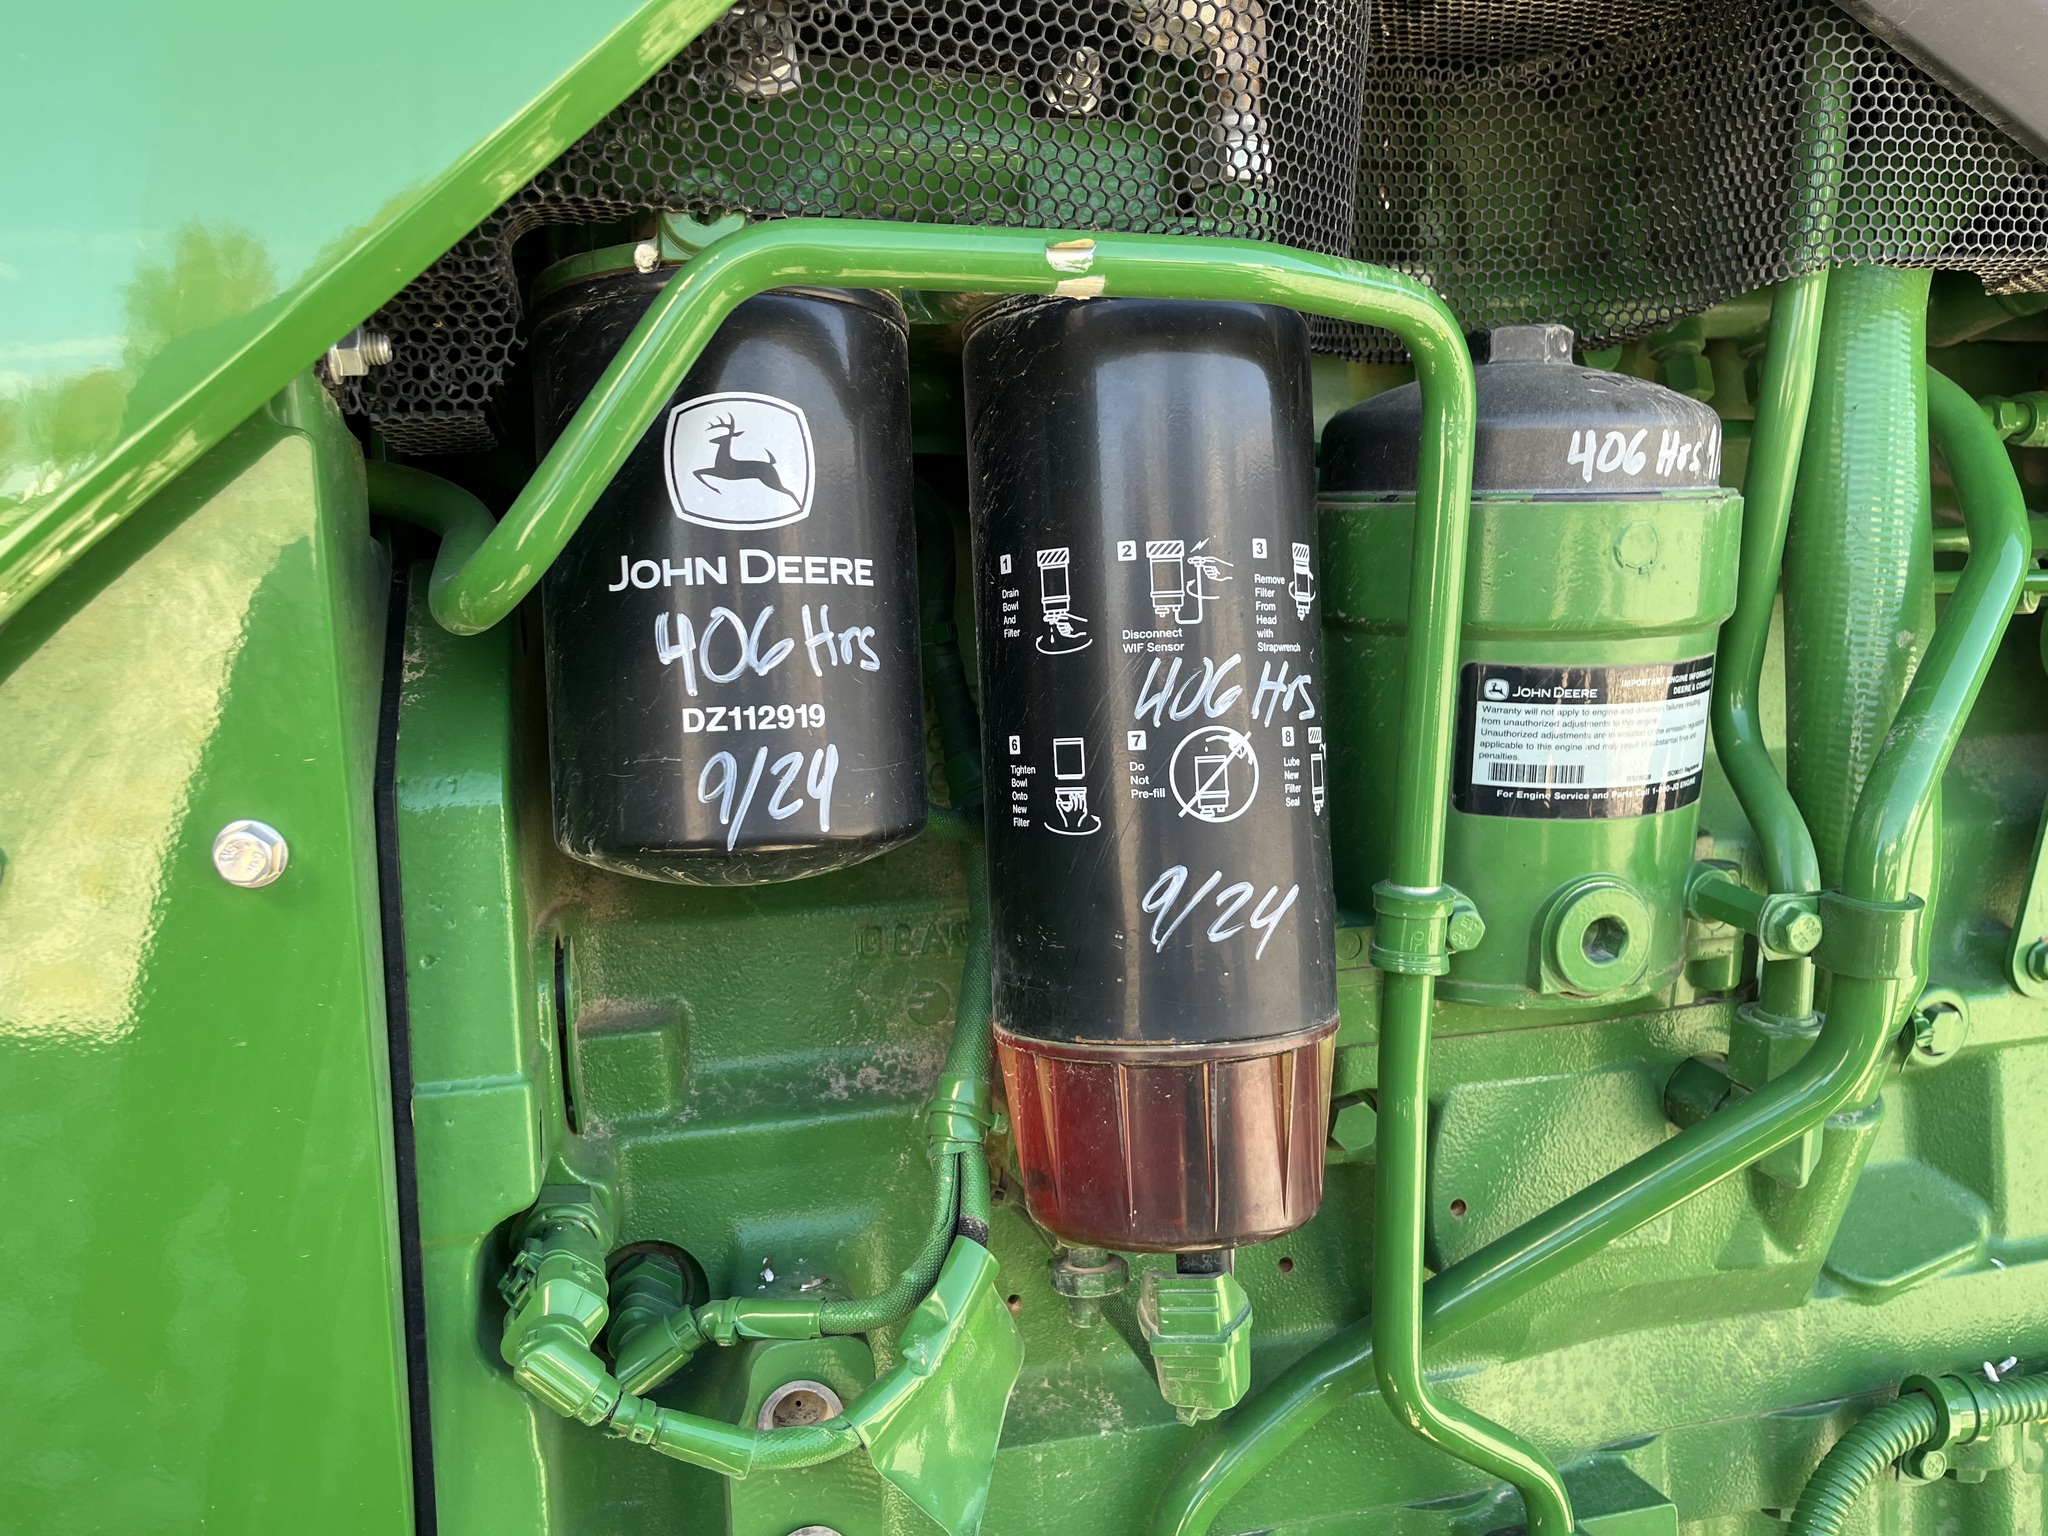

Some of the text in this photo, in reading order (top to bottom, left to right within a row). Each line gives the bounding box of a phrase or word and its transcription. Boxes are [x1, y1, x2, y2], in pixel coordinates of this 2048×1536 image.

[1567, 428, 1648, 483] 406
[1656, 429, 1702, 477] Hrs
[609, 549, 874, 591] JOHN DEERE
[1254, 574, 1285, 585] Remove
[1001, 588, 1020, 599] Drain
[1255, 587, 1275, 598] Filter
[1002, 601, 1019, 612] Bowl
[1255, 600, 1276, 611] From
[1003, 615, 1016, 625] And
[1256, 614, 1277, 625] Head
[1003, 628, 1021, 638] Filter
[1122, 628, 1183, 640] Disconnect
[1256, 628, 1274, 639] with
[655, 604, 881, 697] 406 Hrs
[1122, 641, 1185, 654] WIF Sensor
[1257, 642, 1301, 654] Strapwrench
[1621, 676, 1666, 688] IMPORTANT
[1133, 653, 1316, 728] 406 Hrs
[1512, 686, 1598, 699] JOHN DEERE
[1482, 705, 1522, 717] Warranty
[1524, 707, 1538, 716] will
[1557, 708, 1580, 717] apply
[1592, 708, 1619, 718] engine
[682, 704, 826, 733] DZ112919
[1481, 717, 1501, 726] from
[1504, 719, 1560, 728] unauthorized
[1562, 720, 1611, 729] adjustments
[1481, 728, 1538, 739] Unauthorized
[1541, 731, 1591, 740] adjustments
[1480, 741, 1524, 751] applicable
[1537, 743, 1552, 751] this
[1555, 745, 1583, 753] engine
[1602, 741, 1618, 751] may
[1283, 757, 1300, 767] Lube
[1478, 752, 1520, 761] penalties.
[1010, 765, 1036, 777] Tighten
[1129, 762, 1145, 772] Do
[1130, 775, 1150, 786] Not
[1284, 770, 1300, 780] New
[1011, 778, 1028, 788] Bowl
[1284, 783, 1302, 794] Filter
[698, 743, 840, 852] 9/24
[1012, 791, 1028, 801] Onto
[1131, 788, 1166, 799] Pre-fill
[1496, 790, 1514, 799] For
[1517, 791, 1551, 801] Engine
[1554, 791, 1589, 800] Service
[1592, 791, 1609, 800] and
[1611, 788, 1634, 799] Parts
[1285, 796, 1300, 808] Seal
[1012, 804, 1028, 814] New
[1013, 817, 1030, 827] Filter
[1142, 864, 1300, 961] 9/24
